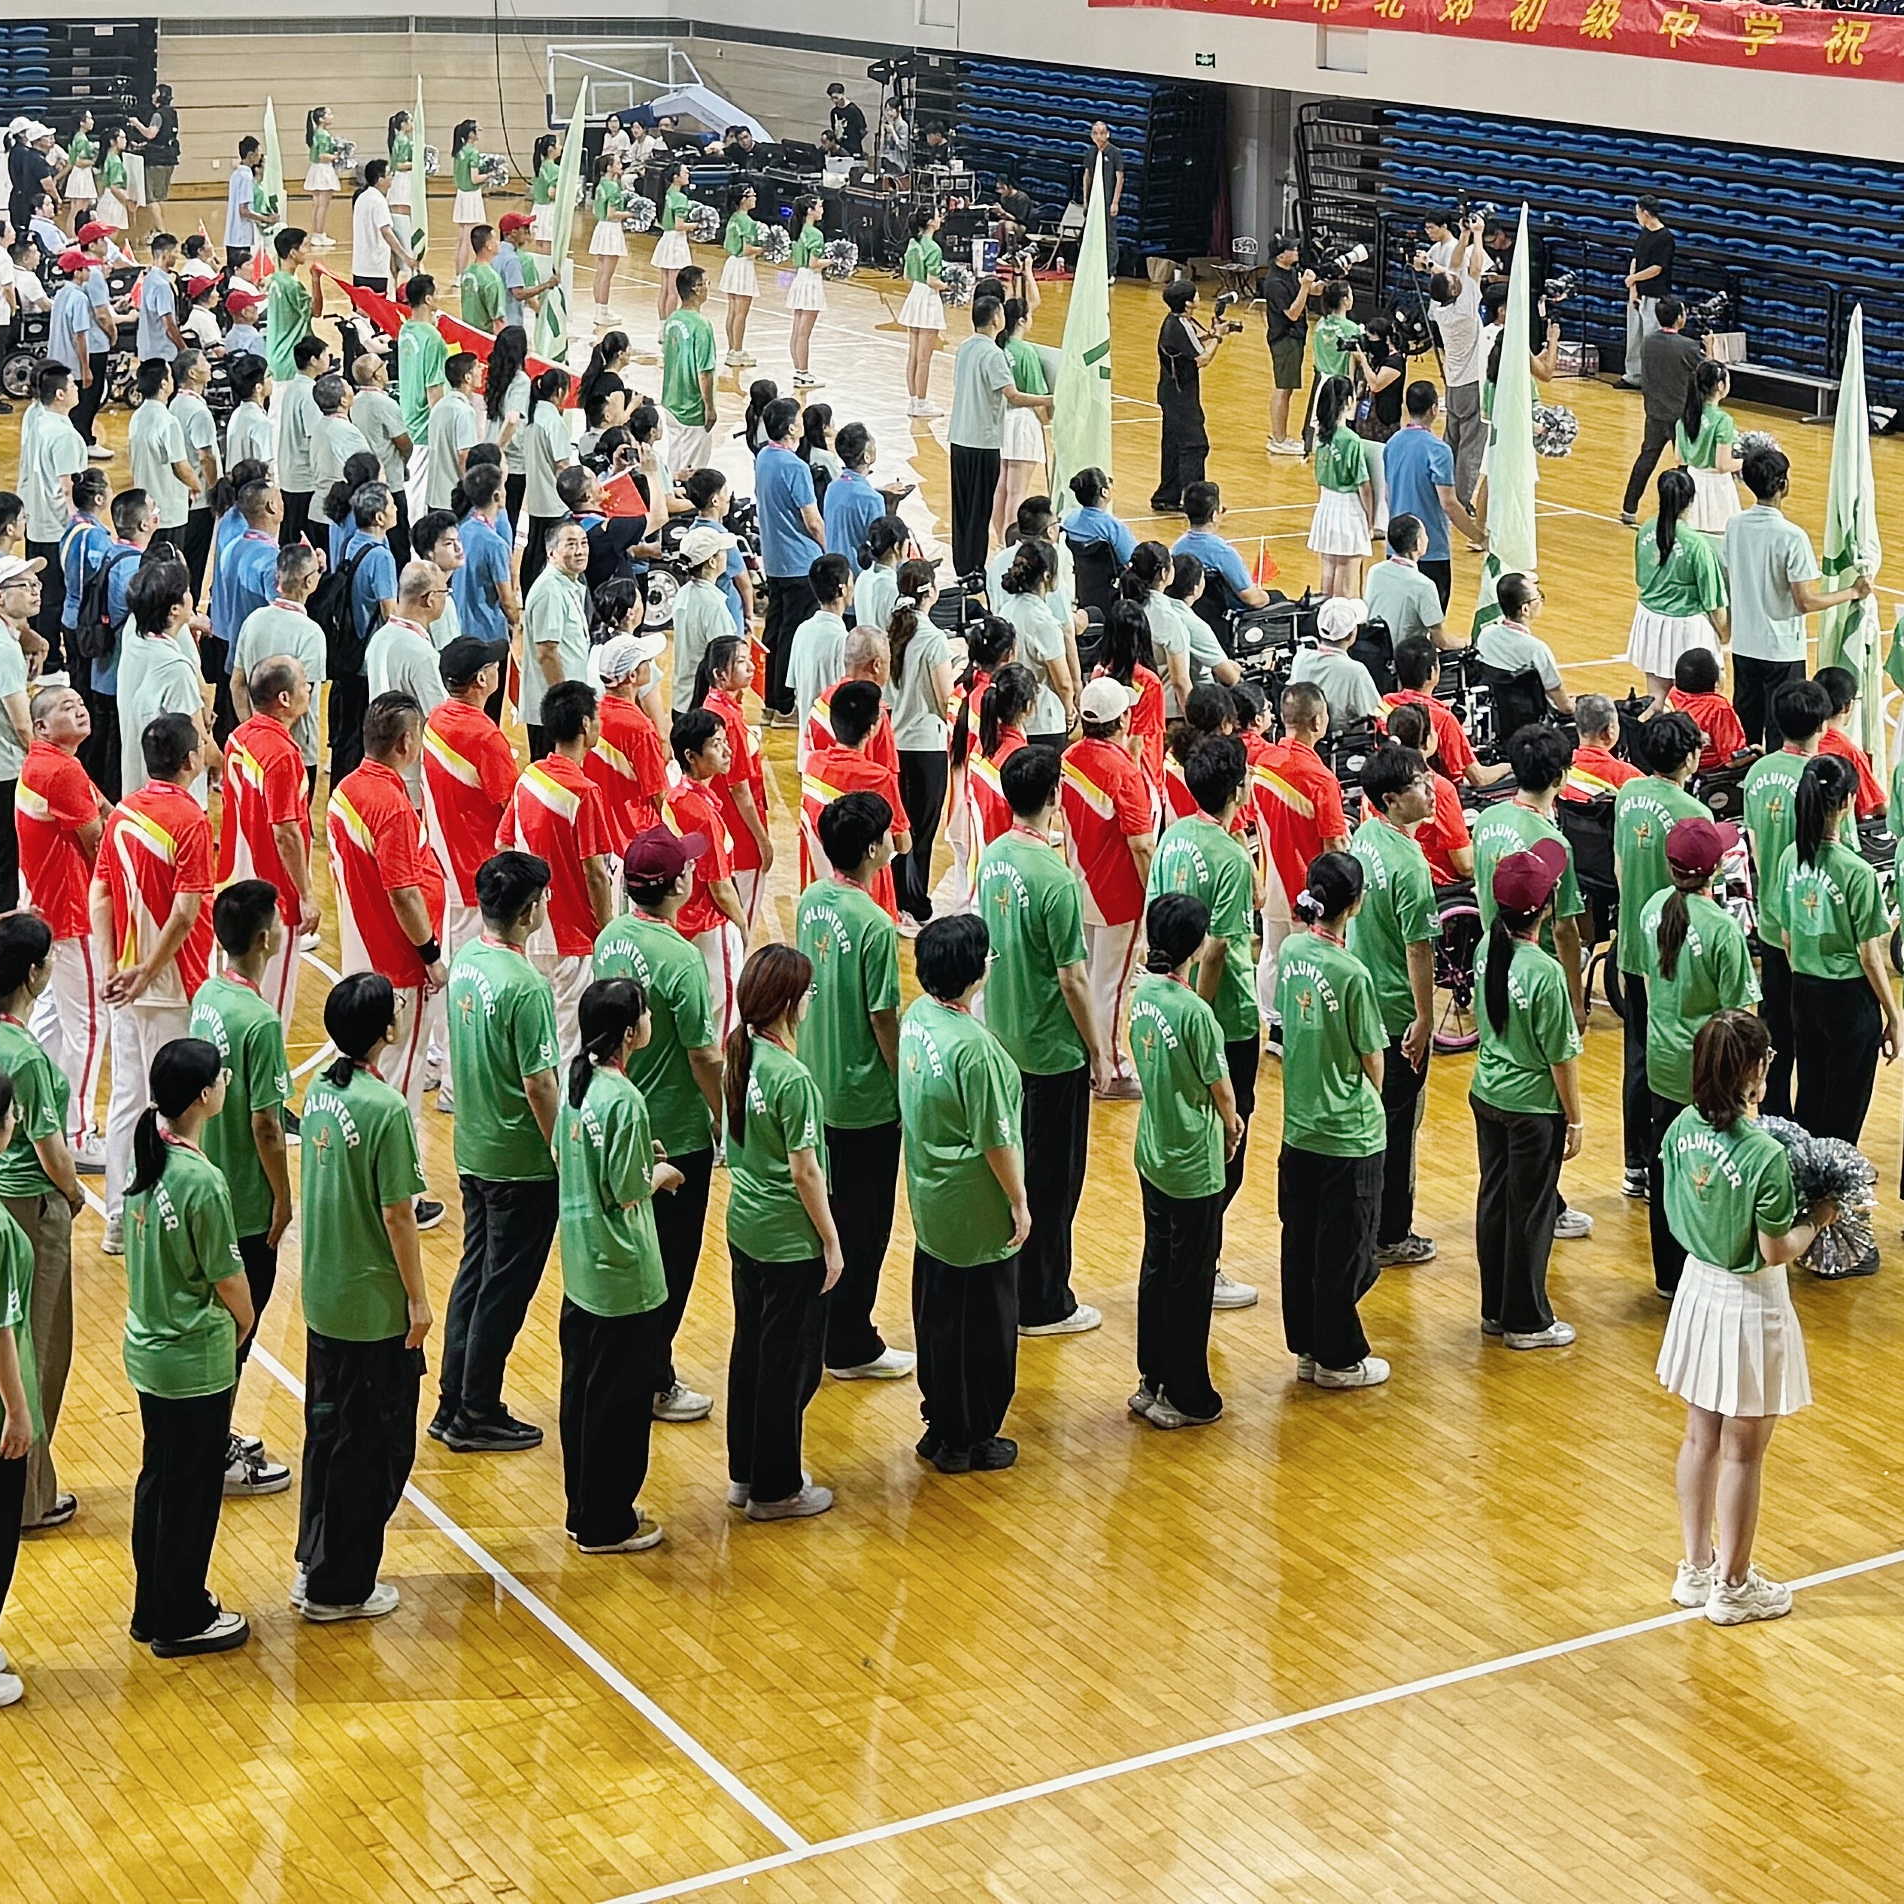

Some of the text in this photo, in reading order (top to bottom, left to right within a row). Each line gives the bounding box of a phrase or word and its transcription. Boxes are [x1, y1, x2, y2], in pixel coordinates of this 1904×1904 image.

[450, 964, 495, 1018] OLUNTEER
[304, 1093, 360, 1148] OLUNTEER
[1676, 1133, 1741, 1190] OLUNTEER
